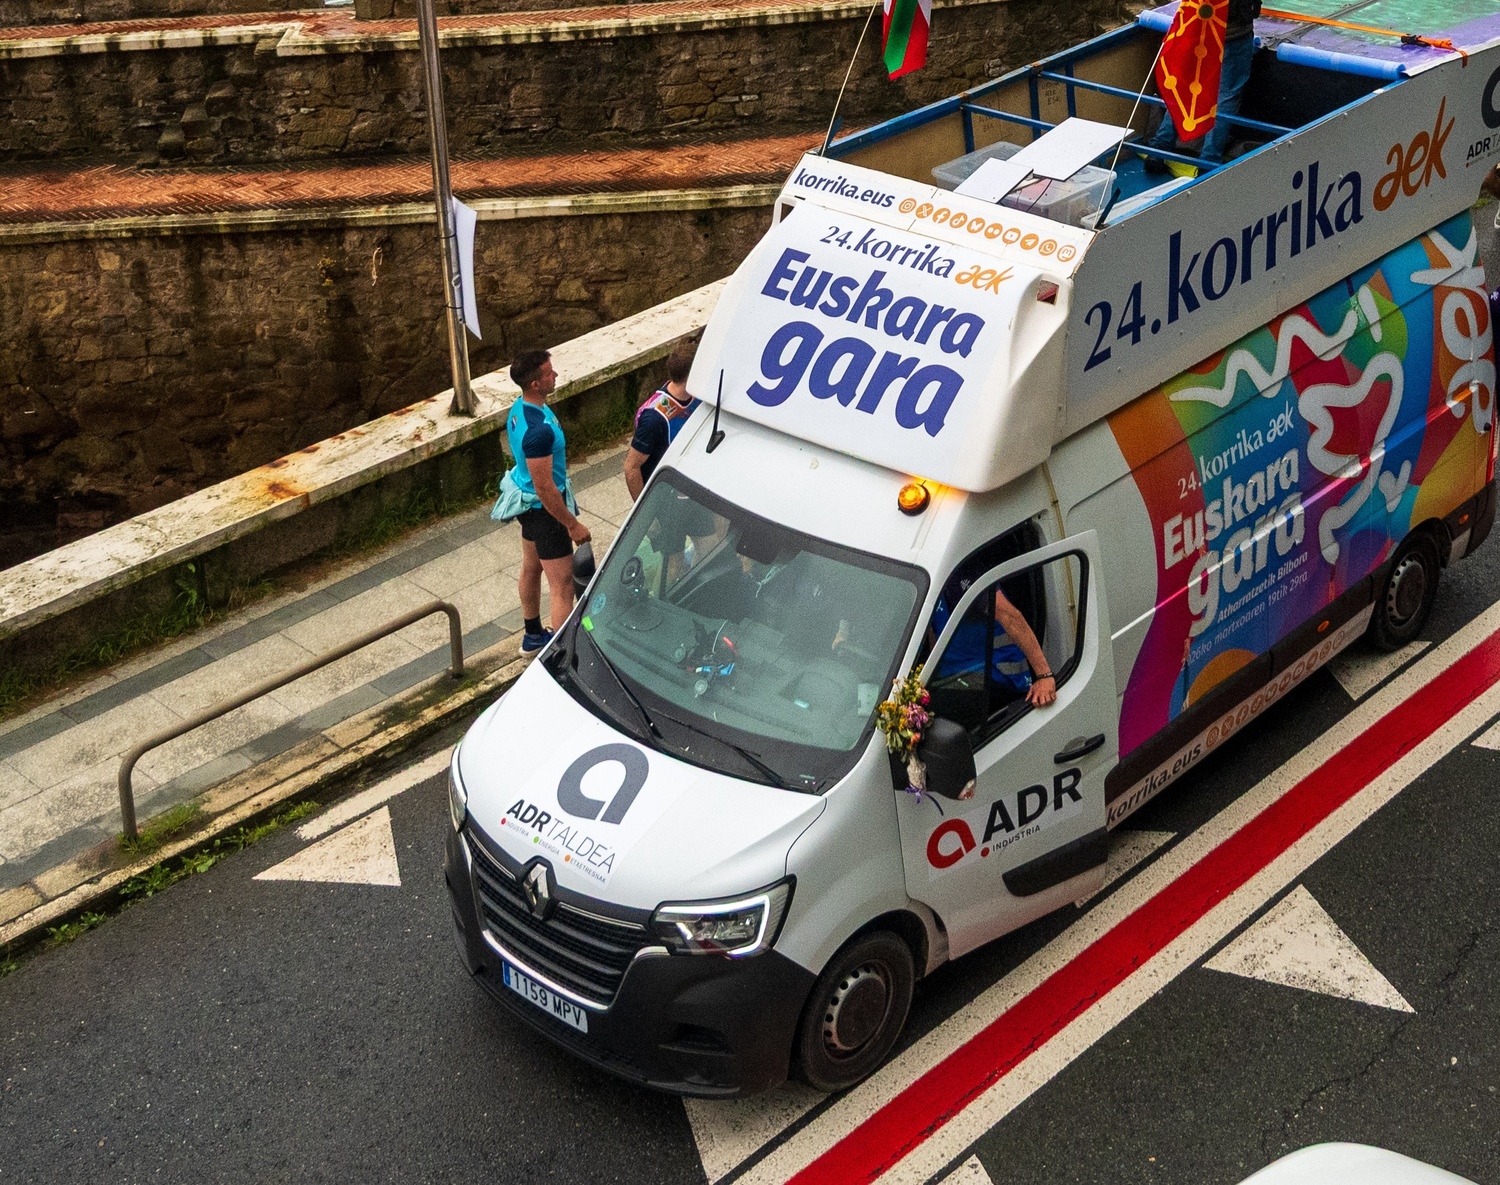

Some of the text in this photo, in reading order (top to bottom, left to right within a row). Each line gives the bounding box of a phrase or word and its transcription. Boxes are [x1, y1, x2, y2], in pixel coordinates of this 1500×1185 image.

[794, 168, 896, 209] korrika.eus
[820, 225, 1014, 296] 24.korrika aek
[1083, 96, 1456, 373] 24.korrika aek
[760, 247, 985, 359] Euskara
[746, 321, 965, 438] gara
[1177, 400, 1295, 500] 24.korrika aek
[1163, 447, 1300, 570] Euskara
[1187, 492, 1306, 638] gara
[1217, 551, 1308, 623] Atharratzetik Bilbora
[1214, 601, 1265, 646] martxoaren
[981, 767, 1083, 844] ADR
[1106, 743, 1202, 826] korrika.eus
[538, 839, 560, 856] ENERGIA
[992, 824, 1041, 853] INDUSTRIA
[513, 971, 582, 1026] 1159 MPV
